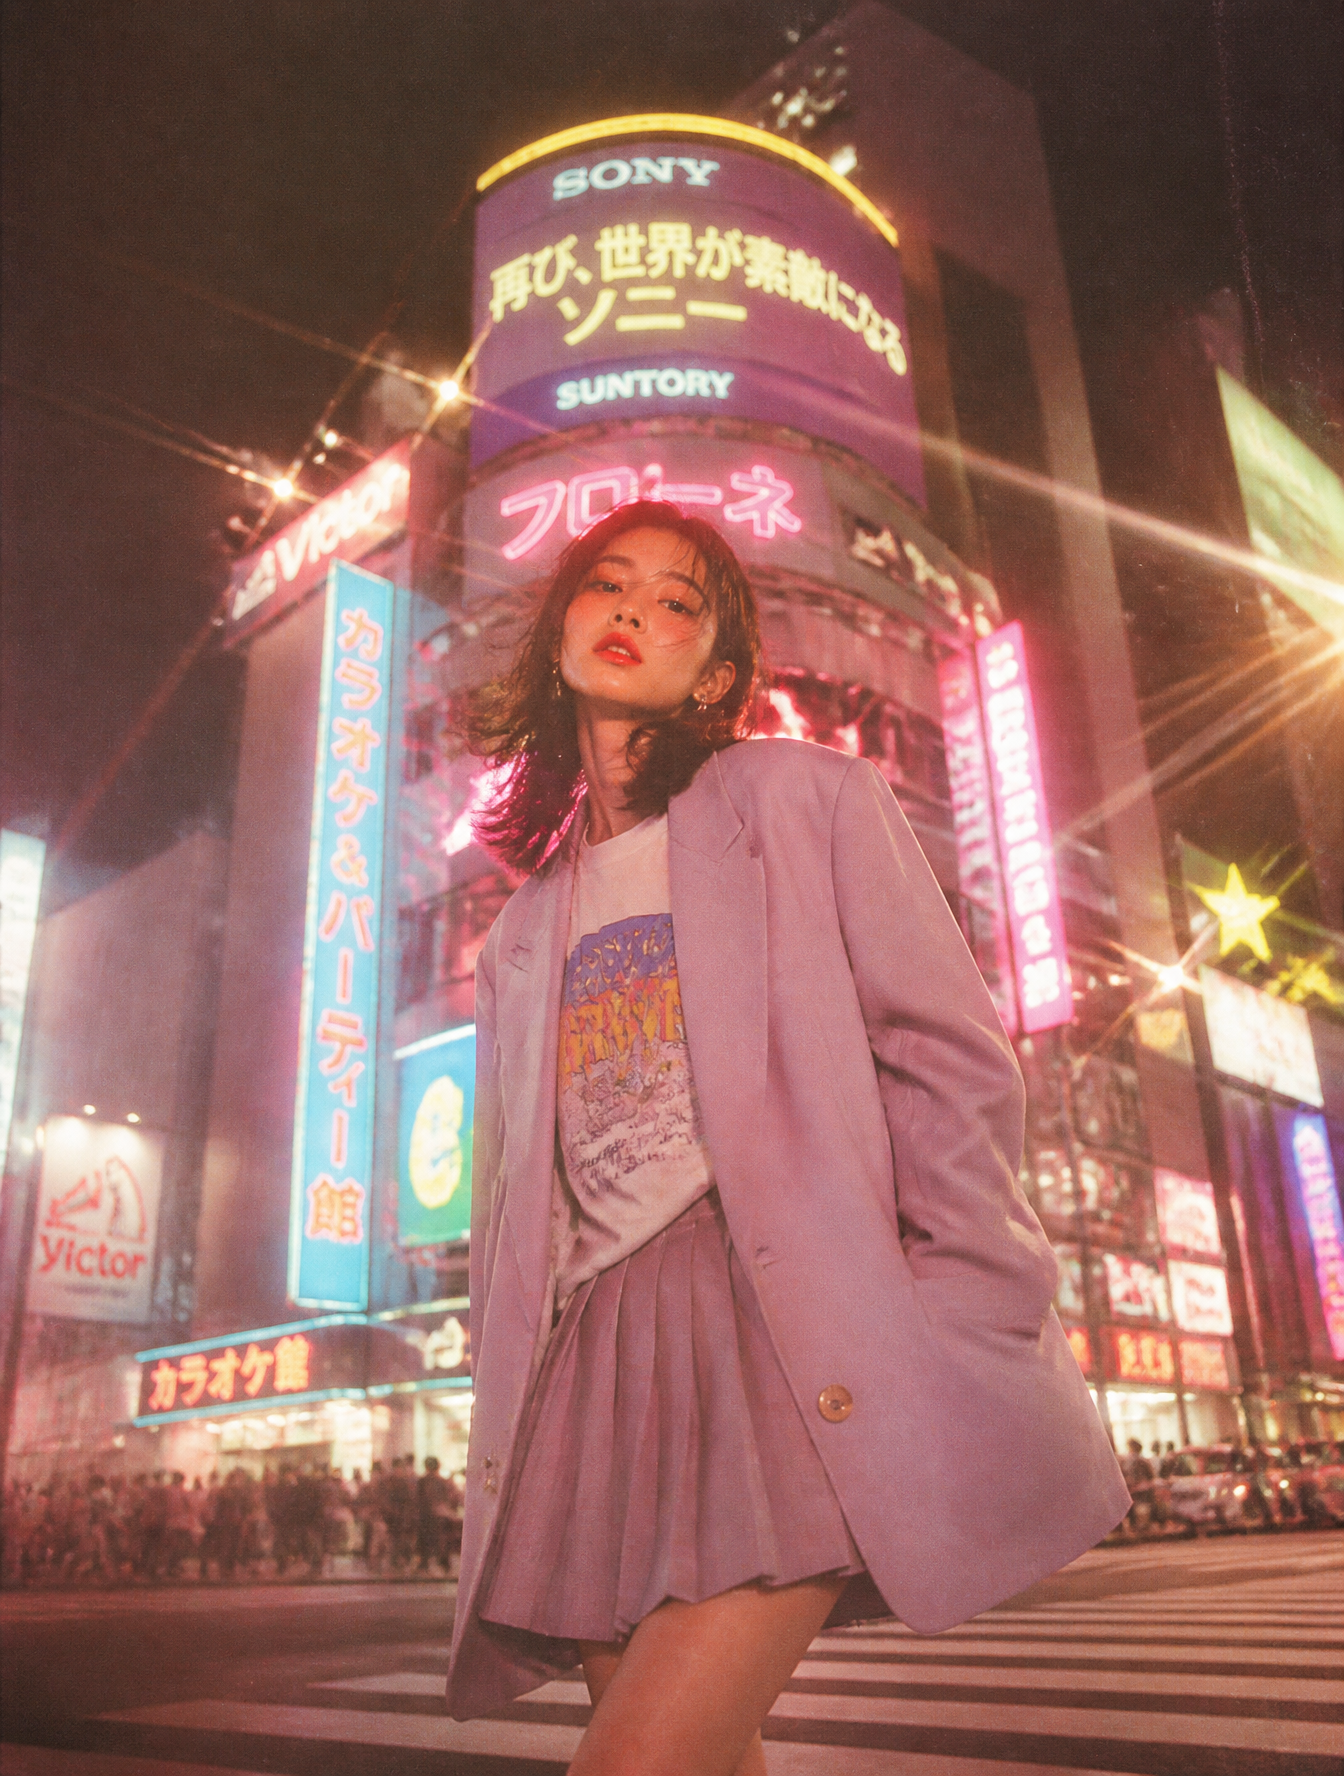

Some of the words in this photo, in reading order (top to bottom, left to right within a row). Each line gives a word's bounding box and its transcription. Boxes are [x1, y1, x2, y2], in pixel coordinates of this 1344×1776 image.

[553, 157, 720, 200] SONY
[489, 222, 907, 376] 再び、世界が素敵になる
[556, 287, 748, 346] ソニー
[557, 368, 734, 410] SUNTORY
[148, 1333, 311, 1411] カラオケ館
